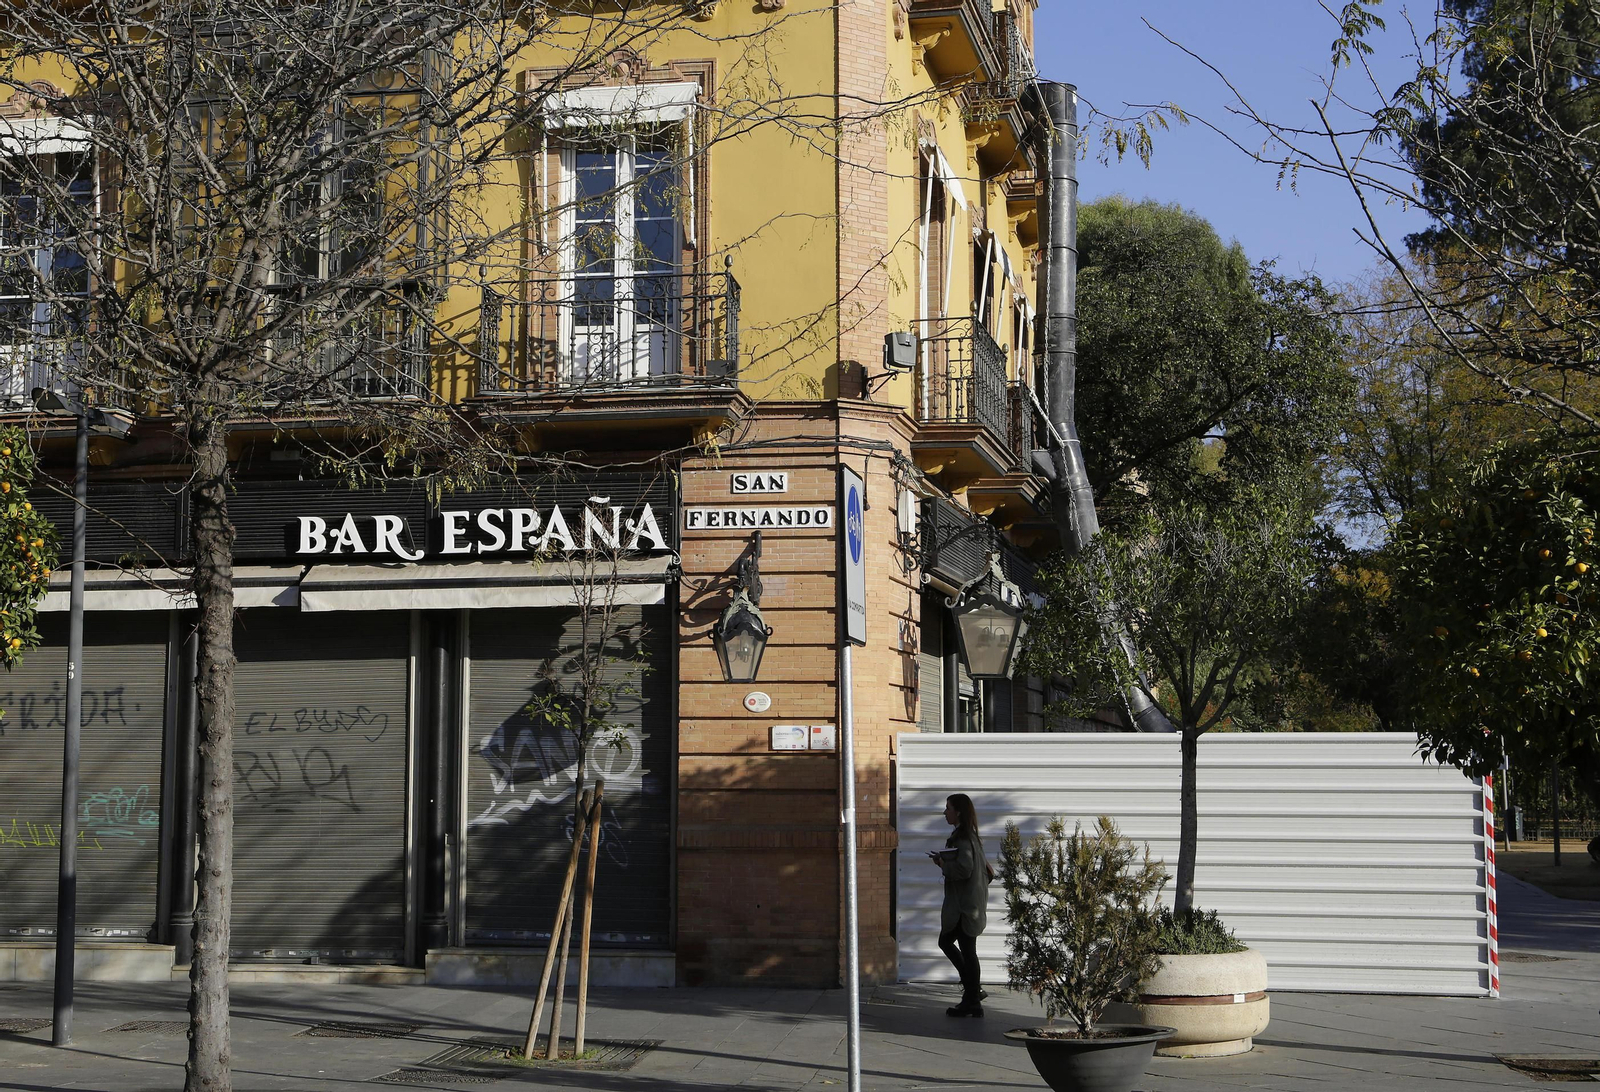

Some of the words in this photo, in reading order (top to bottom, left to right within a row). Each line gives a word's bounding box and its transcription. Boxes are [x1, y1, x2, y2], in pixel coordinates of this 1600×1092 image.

[734, 474, 784, 491] SAN
[688, 509, 829, 527] FERNANDO
[295, 512, 425, 561] BAR
[439, 496, 669, 554] ESPAÑA
